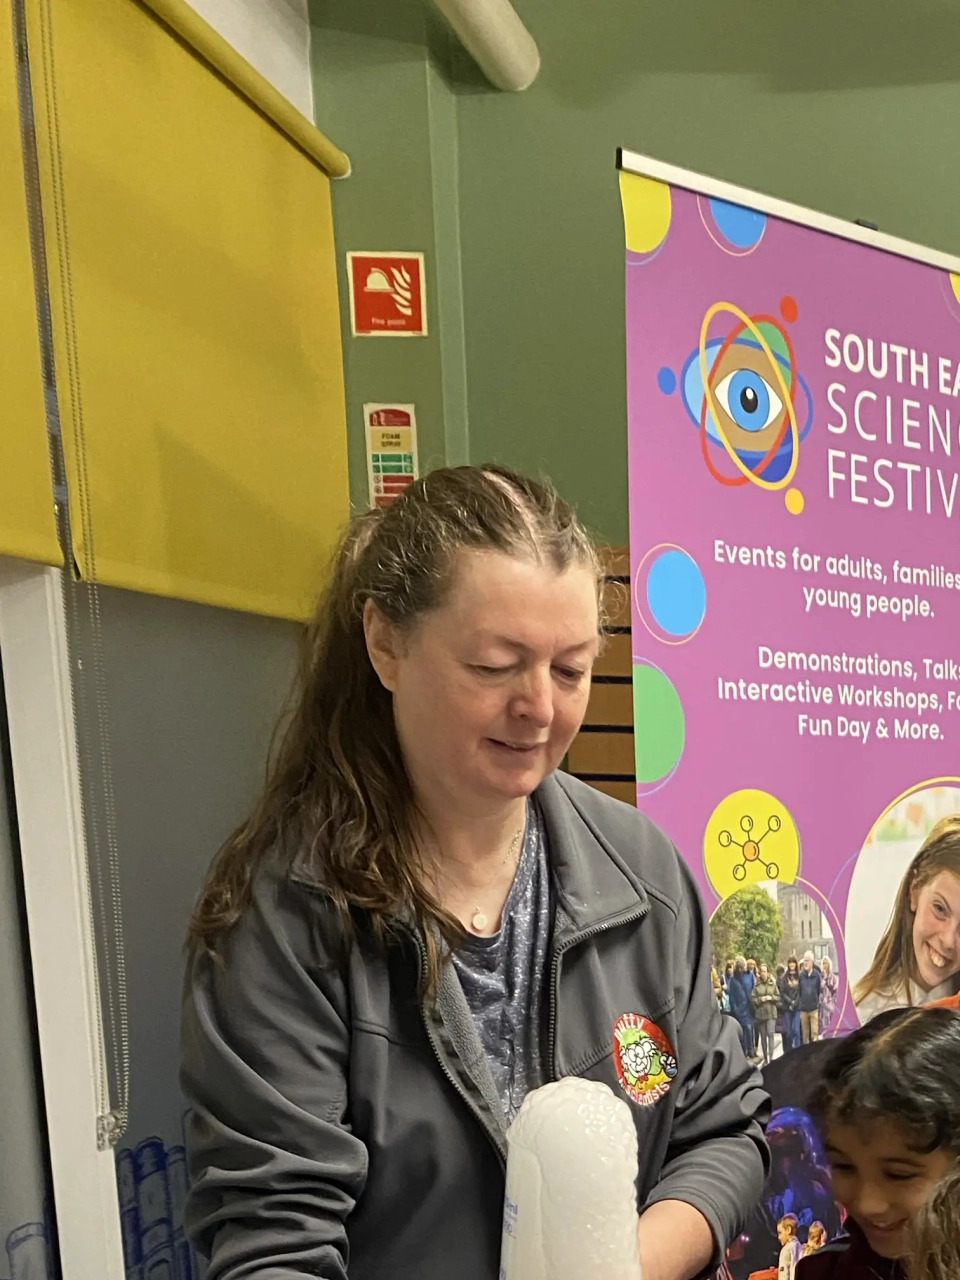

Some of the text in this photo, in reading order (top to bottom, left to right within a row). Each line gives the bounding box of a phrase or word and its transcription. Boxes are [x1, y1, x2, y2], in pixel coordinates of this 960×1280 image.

[824, 327, 929, 390] SOUTH
[714, 540, 786, 569] Events
[792, 547, 820, 573] for
[826, 554, 888, 585] adults,
[803, 585, 935, 622] young people.
[758, 646, 918, 681] Demonstrations,
[717, 677, 833, 704] Interactive
[838, 684, 943, 715] Workshops,
[798, 715, 945, 744] Fun Day & More.
